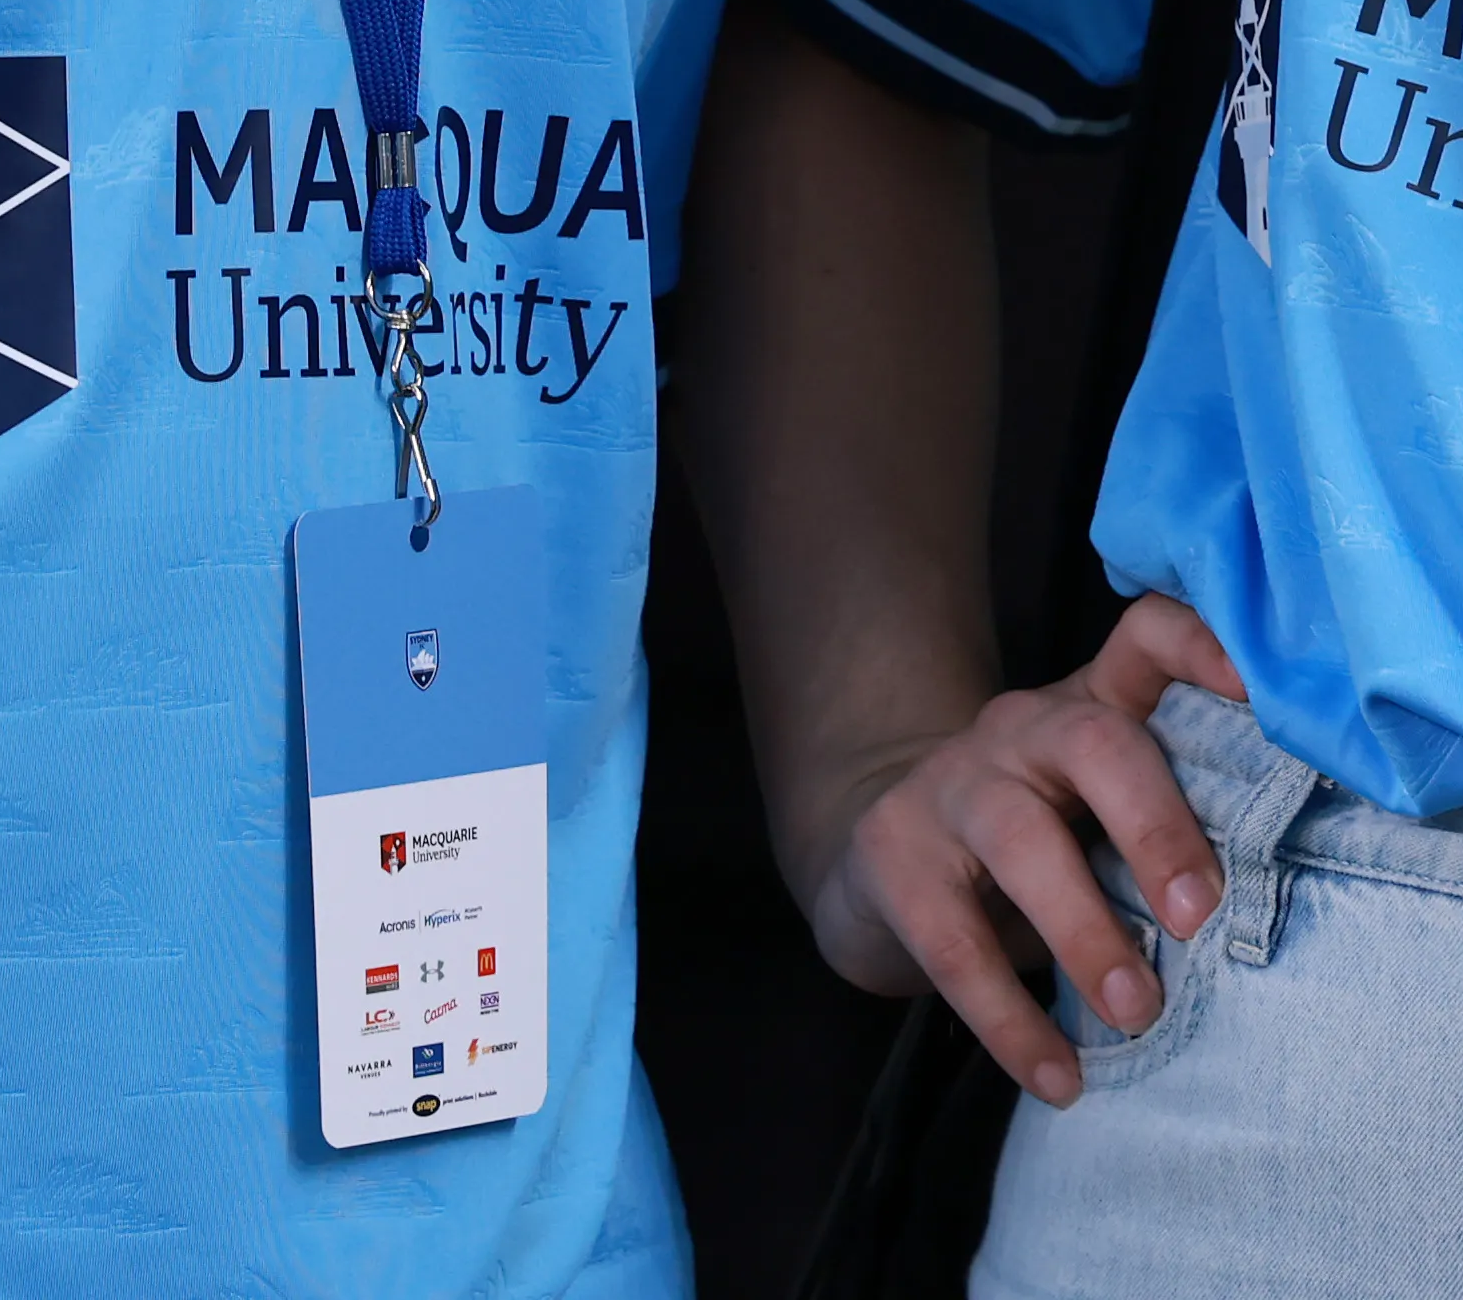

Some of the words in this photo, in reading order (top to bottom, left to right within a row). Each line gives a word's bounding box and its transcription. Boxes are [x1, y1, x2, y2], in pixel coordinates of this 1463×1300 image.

[166, 264, 628, 404] University
[412, 826, 478, 849] MACQUARIE
[412, 846, 461, 864] University
[379, 919, 416, 934] Acronis
[424, 908, 461, 928] Hyperix
[424, 998, 458, 1024] Carma
[347, 1059, 393, 1075] NAVARRA
[416, 1099, 437, 1113] snap
